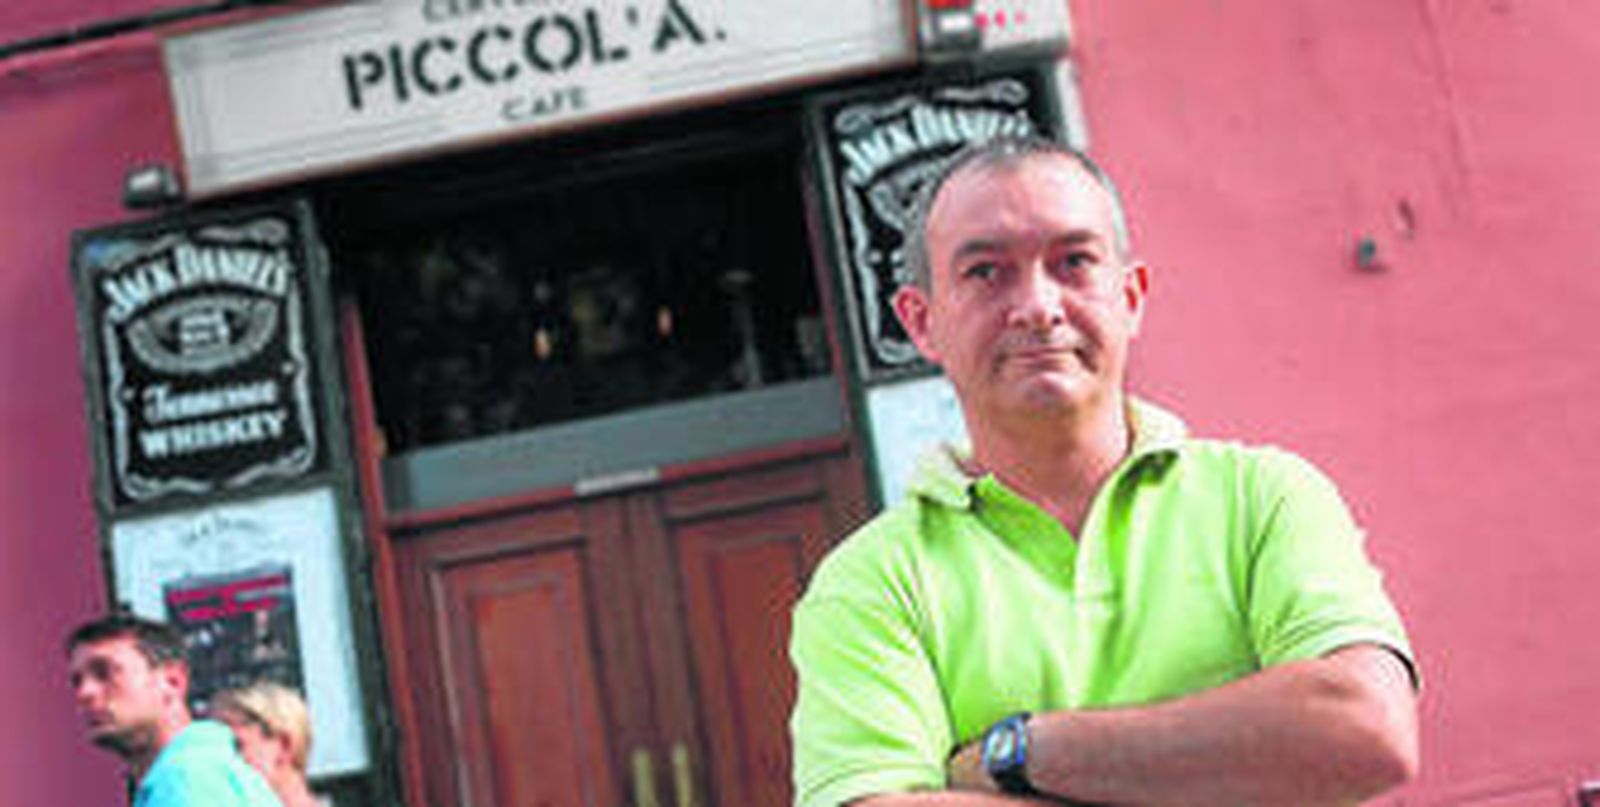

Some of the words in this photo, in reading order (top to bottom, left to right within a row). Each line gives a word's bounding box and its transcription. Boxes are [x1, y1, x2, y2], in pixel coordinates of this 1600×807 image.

[840, 121, 918, 187] JACK
[104, 260, 178, 323] JACK
[138, 408, 287, 459] WHISKEY
